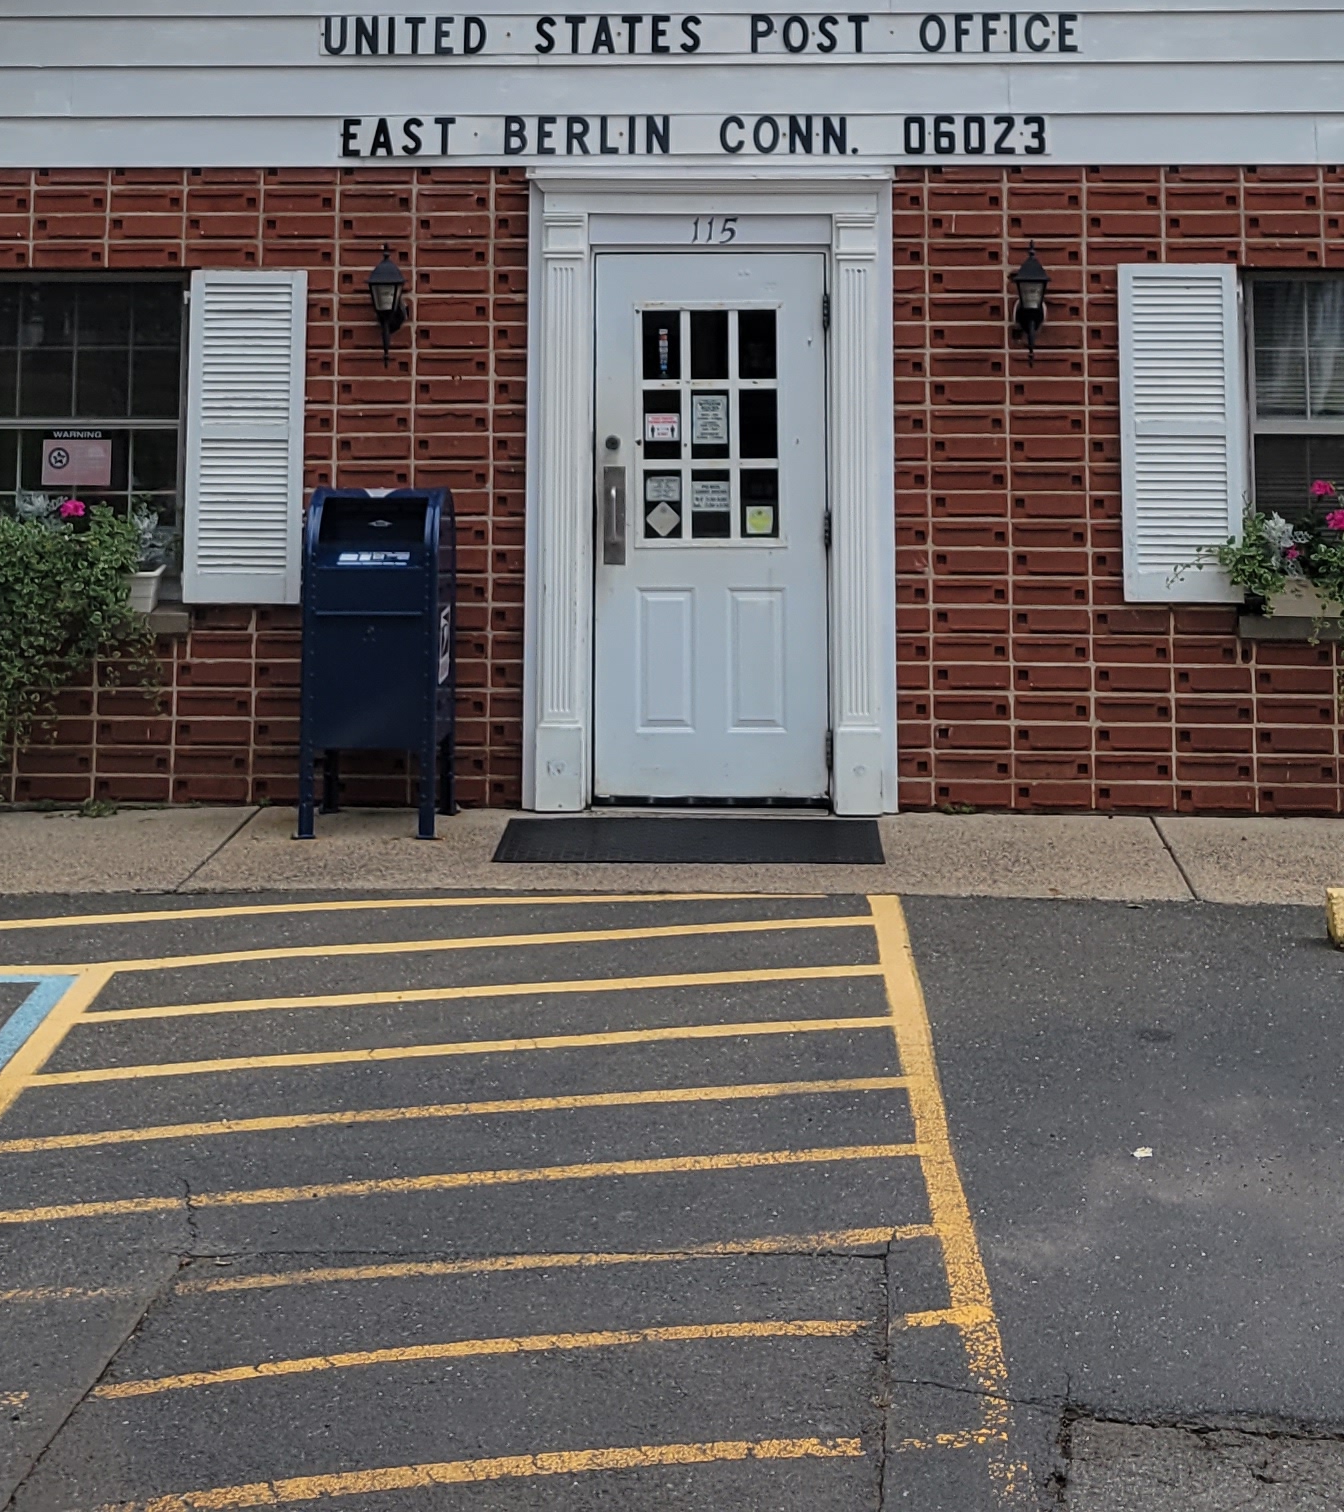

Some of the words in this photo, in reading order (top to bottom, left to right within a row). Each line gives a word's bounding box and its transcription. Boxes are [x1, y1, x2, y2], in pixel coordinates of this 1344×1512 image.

[323, 15, 487, 57] UNITED
[535, 14, 701, 56] STATES
[751, 13, 869, 54] POST
[919, 12, 1078, 53] OFFICE
[340, 116, 456, 158] EAST
[504, 115, 670, 156] BERLIN
[720, 115, 859, 155] CONN.
[903, 114, 1047, 155] 06023
[691, 217, 739, 244] 115
[53, 430, 103, 439] WARNING
